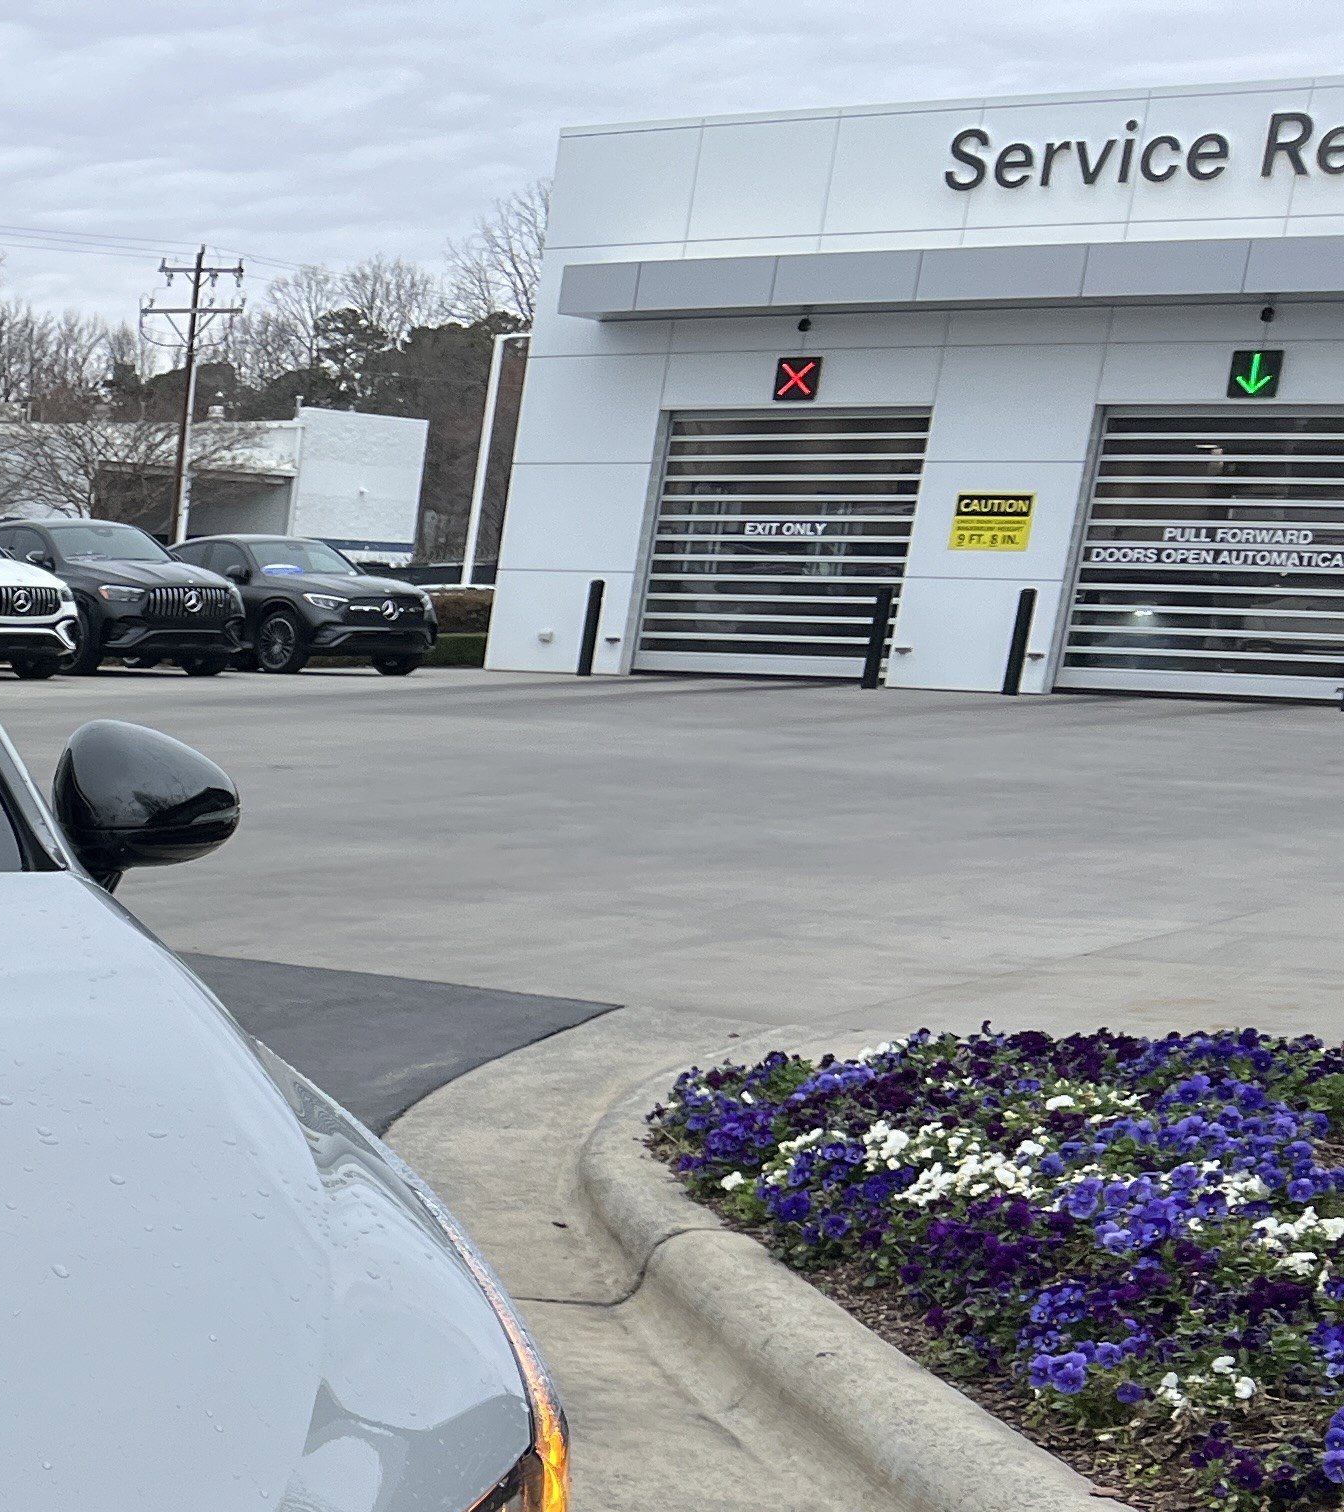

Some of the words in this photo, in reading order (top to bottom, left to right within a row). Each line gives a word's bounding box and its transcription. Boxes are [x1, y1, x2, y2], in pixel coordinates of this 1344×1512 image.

[945, 119, 1229, 191] Service
[1261, 113, 1344, 178] Re
[960, 499, 1030, 513] CAUTION
[744, 522, 780, 535] EXIT
[782, 522, 827, 536] ONLY
[1163, 527, 1212, 543] PULL
[1214, 529, 1313, 544] FORWARD
[957, 533, 966, 546] 9
[968, 533, 987, 545] FT.
[1001, 534, 1020, 545] IN.
[1090, 548, 1158, 563] DOORS
[1162, 549, 1213, 564] OPEN
[1216, 550, 1344, 567] AUTOMATICA
